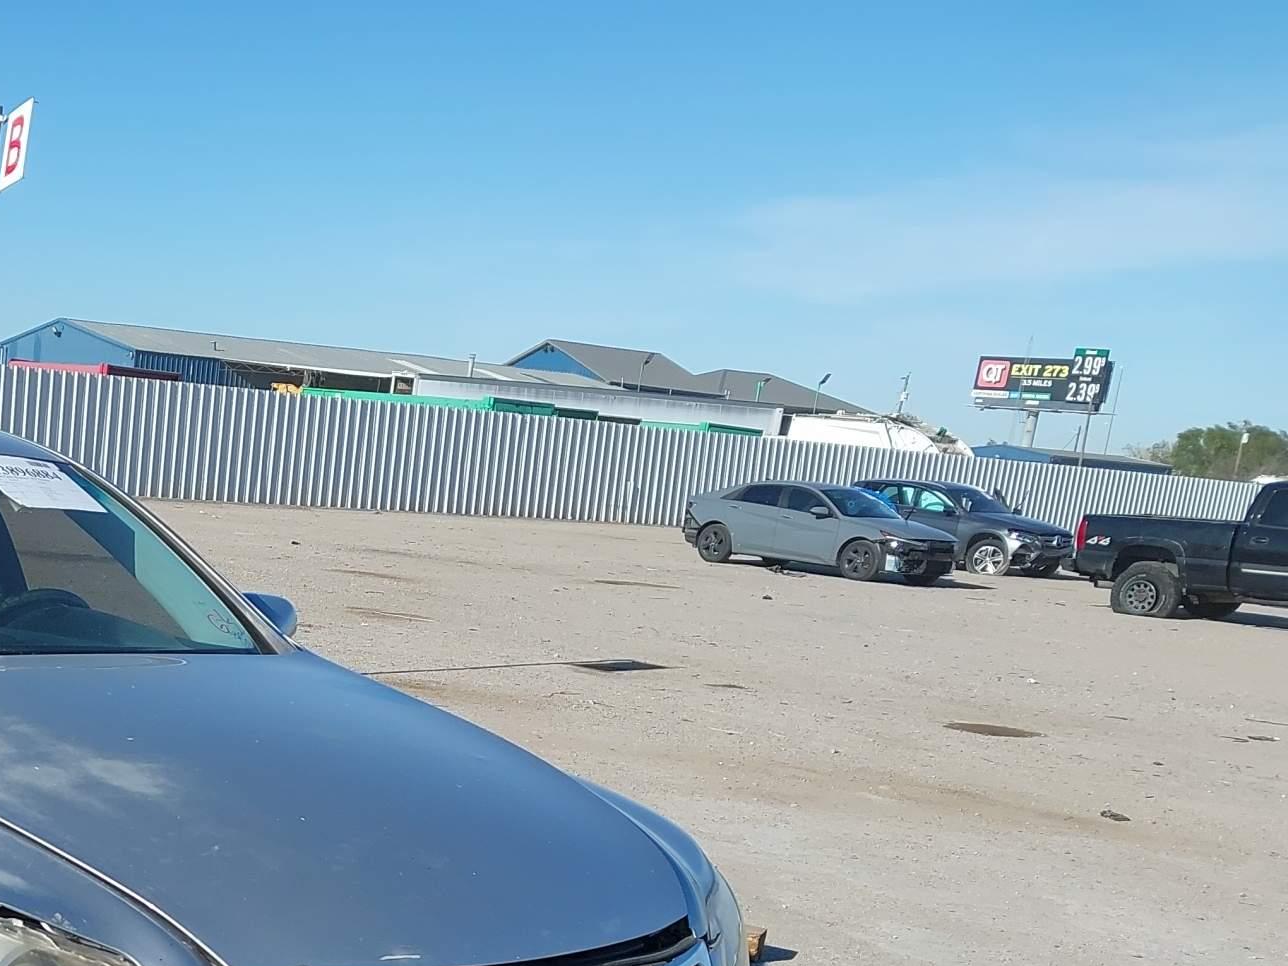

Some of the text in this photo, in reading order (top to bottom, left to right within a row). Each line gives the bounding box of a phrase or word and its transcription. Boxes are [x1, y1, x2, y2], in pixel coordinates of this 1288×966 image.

[5, 115, 24, 176] B
[983, 364, 1005, 383] QT
[1011, 364, 1069, 378] EXIT 273
